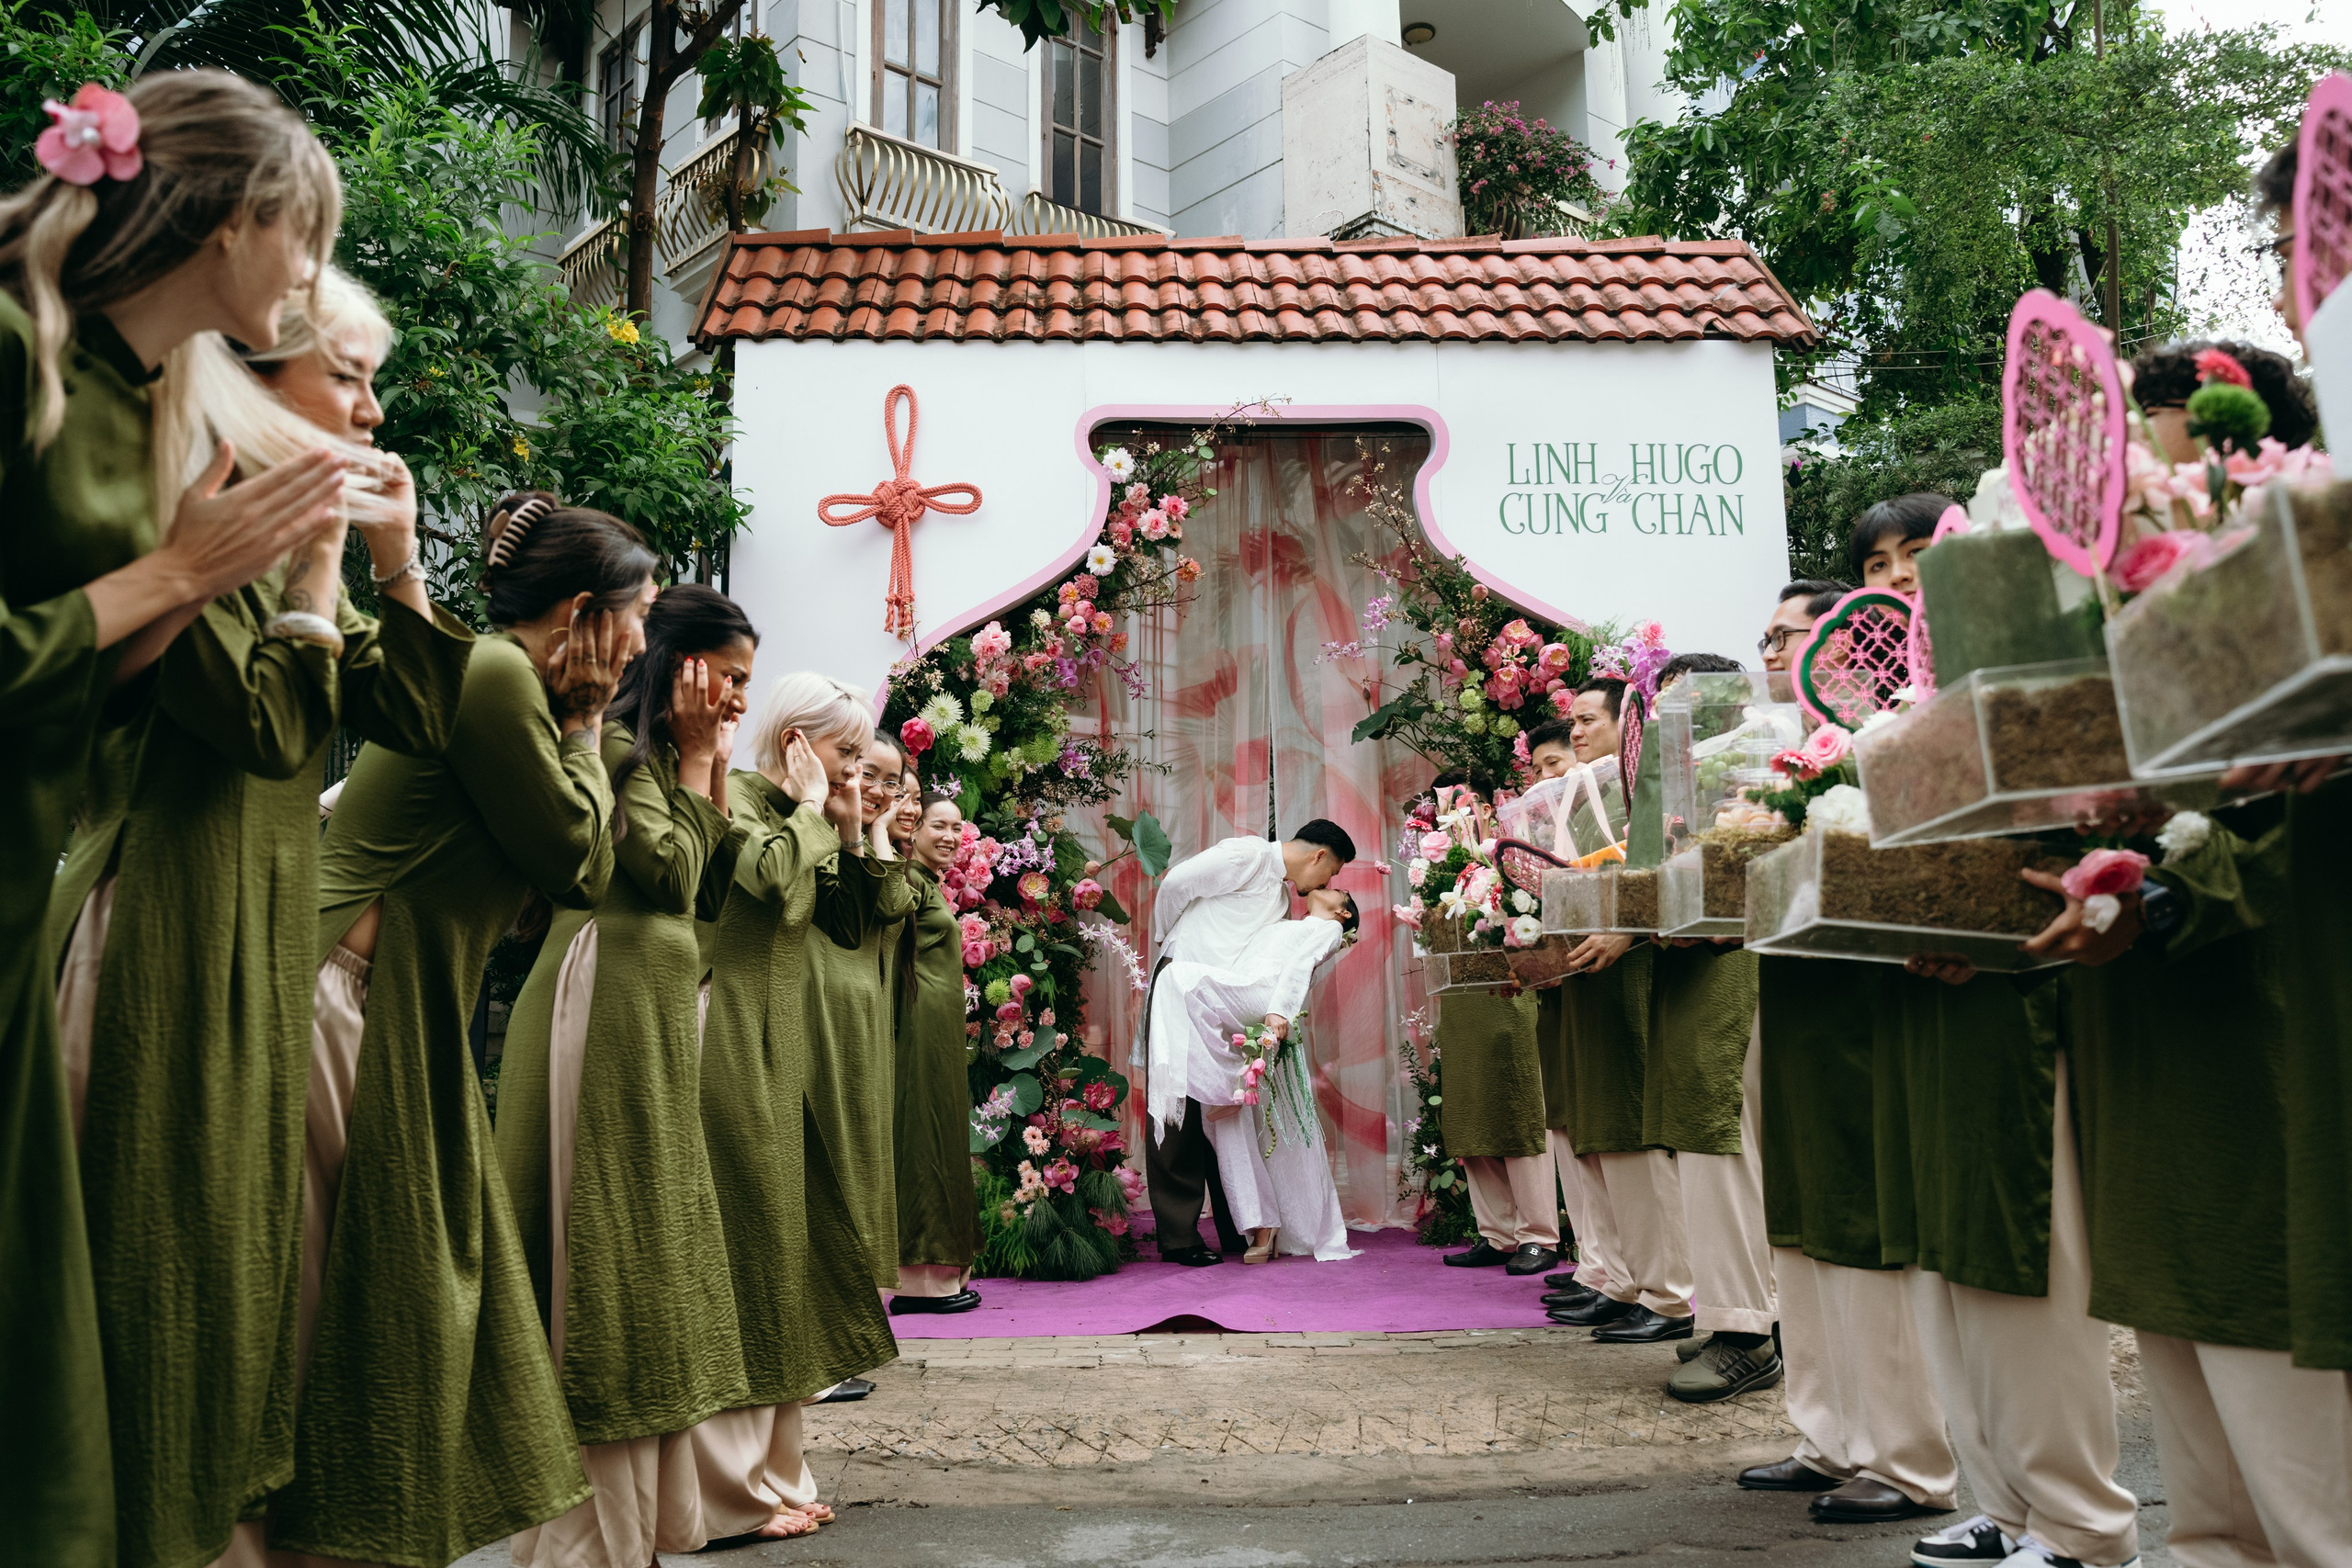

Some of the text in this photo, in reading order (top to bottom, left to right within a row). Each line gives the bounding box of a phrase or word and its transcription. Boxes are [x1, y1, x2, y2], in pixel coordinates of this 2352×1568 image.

[1506, 442, 1743, 485] LINH HUGO
[1499, 492, 1745, 536] CUNG CHAN
